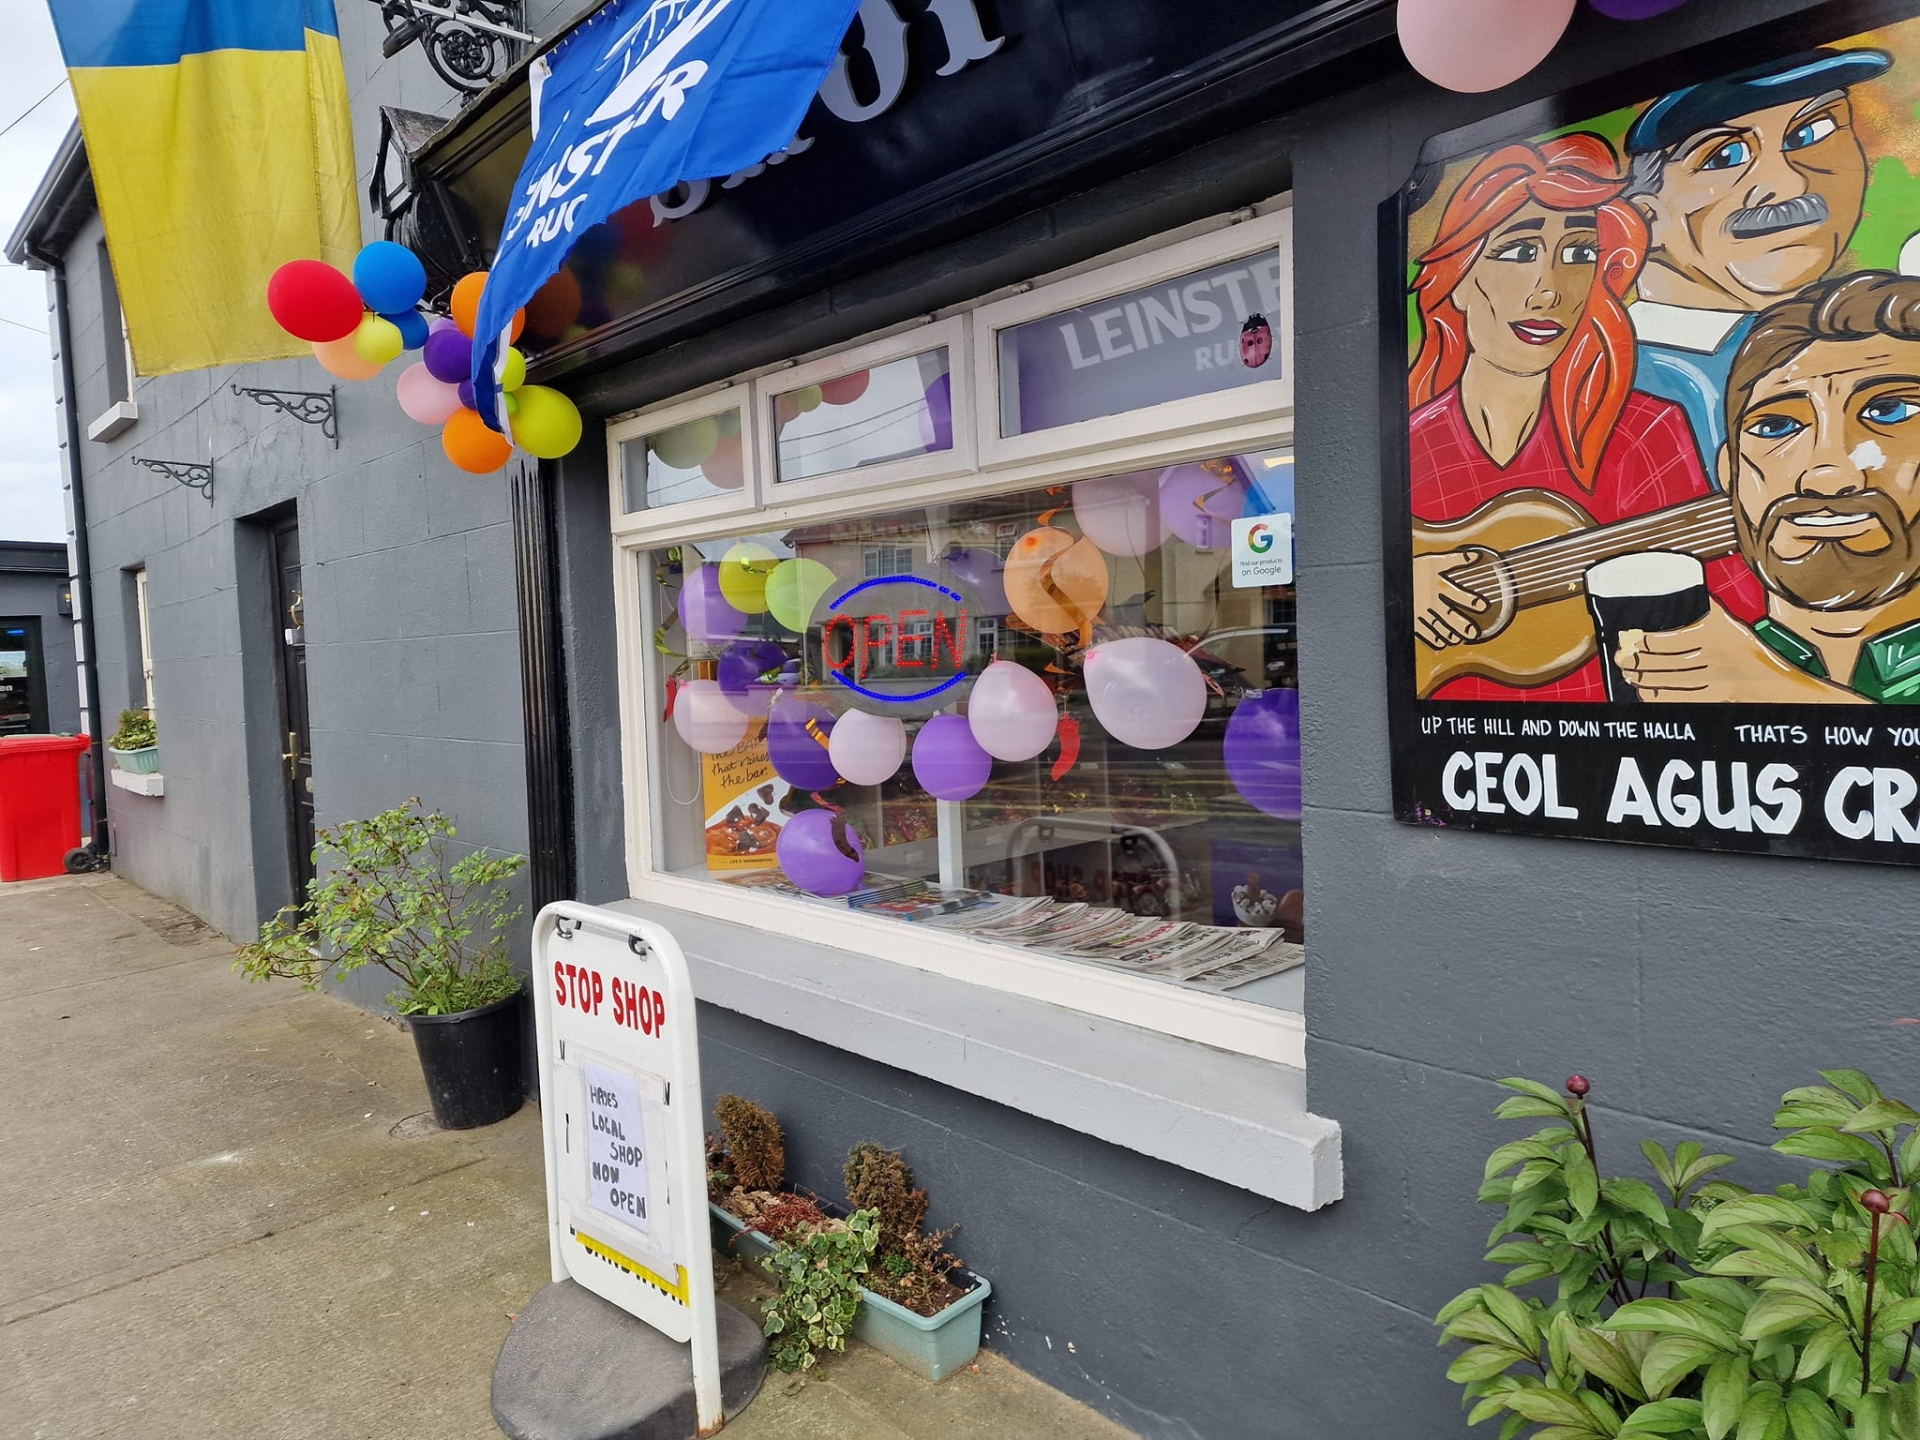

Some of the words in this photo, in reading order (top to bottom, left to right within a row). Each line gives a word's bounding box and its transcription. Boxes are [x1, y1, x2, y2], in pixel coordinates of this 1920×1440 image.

[1253, 565, 1282, 576] Google
[1260, 558, 1283, 566] products
[823, 608, 969, 680] OPEN
[1421, 715, 1442, 735] UP
[1446, 717, 1477, 735] THE
[1484, 717, 1515, 736] HILL
[1521, 718, 1552, 736] AND
[1559, 719, 1600, 738] DOWN
[1604, 721, 1638, 739] THE
[1643, 721, 1696, 741] HALLA
[1734, 724, 1808, 744] THATS
[1824, 726, 1873, 746] HOW
[711, 759, 739, 776] that
[740, 751, 770, 768] raises
[720, 773, 746, 789] the
[746, 766, 769, 782] bar.
[1442, 751, 1579, 820] CEOL
[1606, 756, 1802, 835] AGUS
[1824, 766, 1920, 844] CR
[555, 961, 603, 1016] STOP
[611, 976, 665, 1039] SHOP
[590, 1084, 618, 1109] HAYES
[592, 1111, 626, 1141] LOCAL
[610, 1142, 643, 1168] SHOP
[592, 1161, 620, 1184] NOW
[610, 1187, 647, 1219] OPEN
